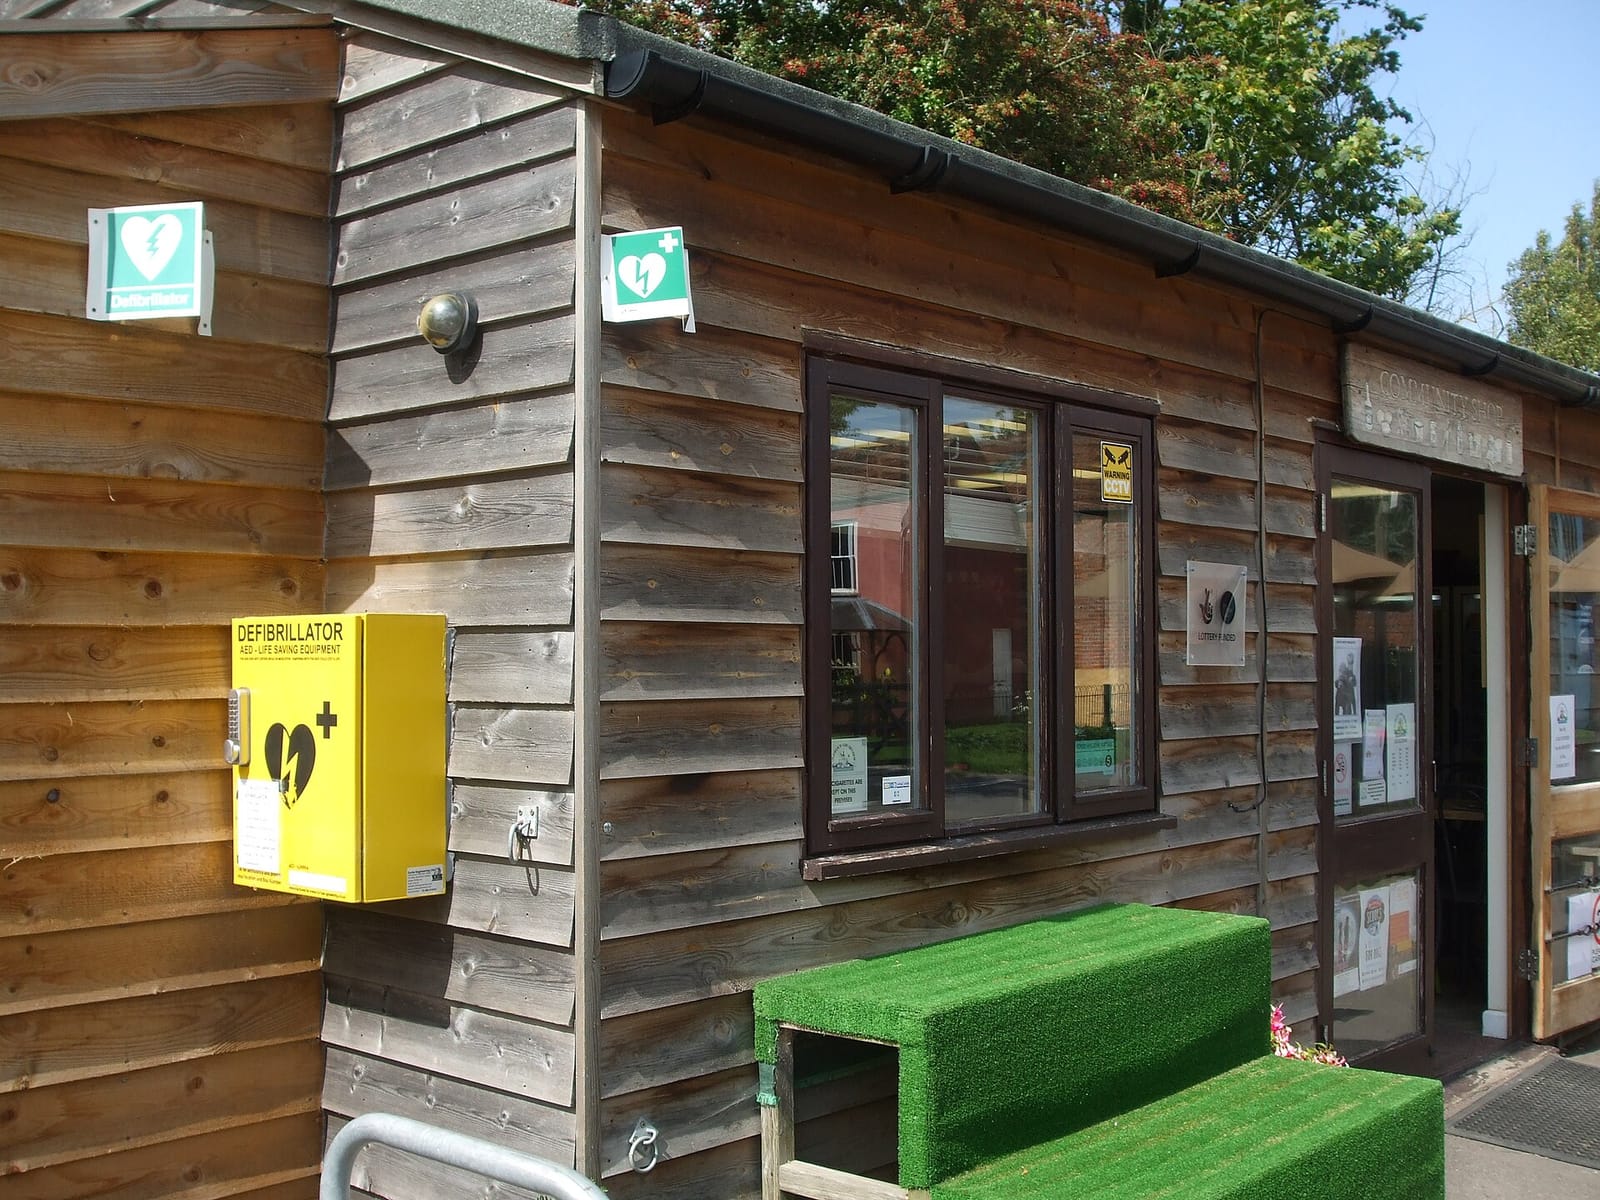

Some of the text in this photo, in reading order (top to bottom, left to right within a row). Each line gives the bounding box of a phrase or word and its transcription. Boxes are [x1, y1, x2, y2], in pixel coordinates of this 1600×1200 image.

[112, 292, 189, 308] Defibrillator
[1380, 370, 1504, 421] COMMUNITY SHOP
[1104, 471, 1130, 481] WARNING
[1104, 480, 1131, 495] CCTV
[238, 622, 343, 642] DEFIBRILLATOR
[1198, 632, 1217, 641] LOTTERY
[240, 644, 253, 655] AED
[258, 644, 272, 655] LIFE
[273, 644, 298, 654] SAVING
[299, 644, 341, 654] EQUIPMENT
